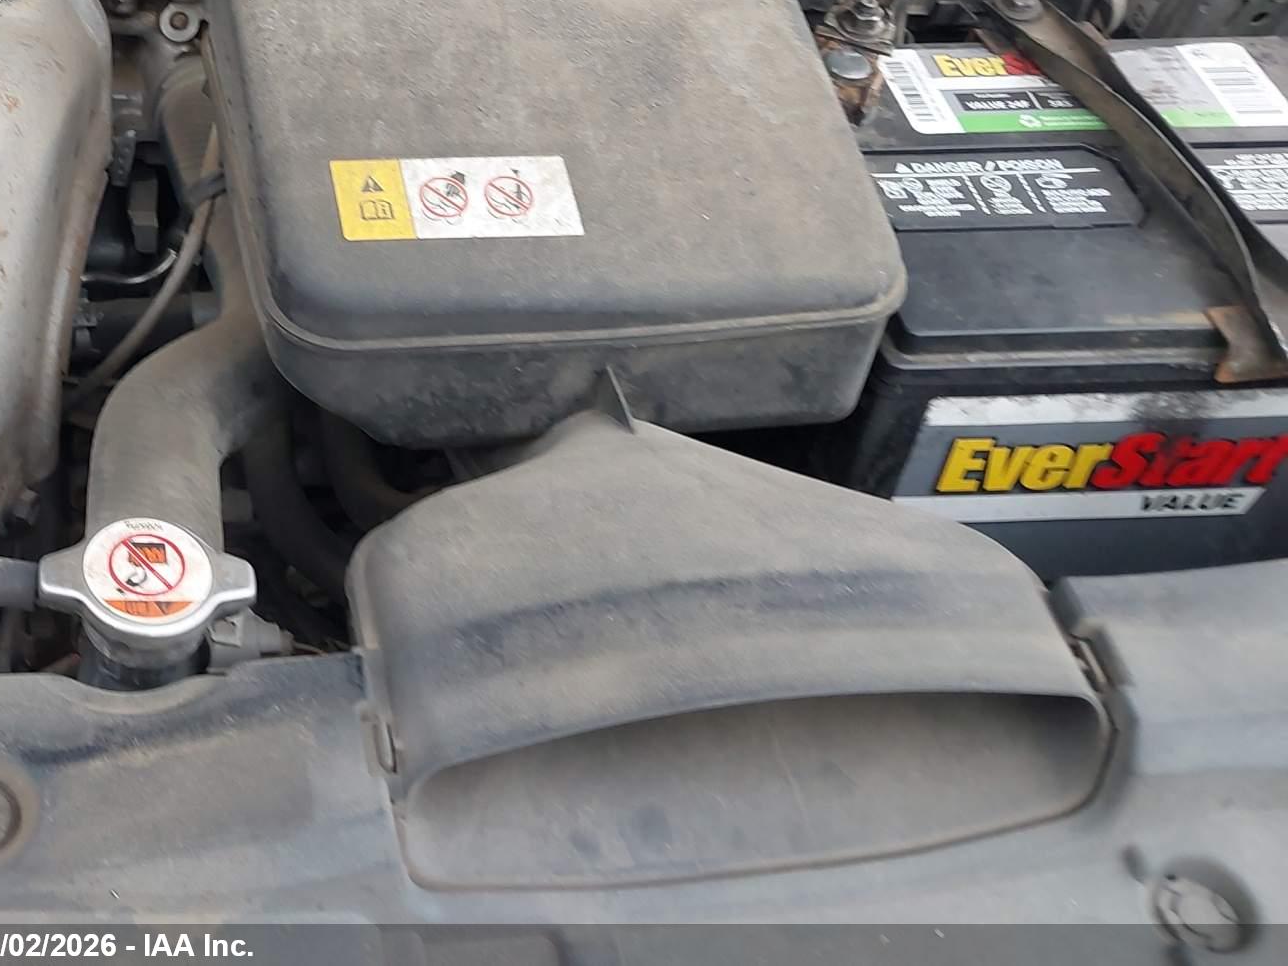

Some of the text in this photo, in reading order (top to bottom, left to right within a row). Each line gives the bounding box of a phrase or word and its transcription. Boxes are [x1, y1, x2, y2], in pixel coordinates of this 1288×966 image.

[931, 52, 1044, 77] EverS
[910, 161, 984, 173] DANGER
[996, 158, 1065, 171] POISON
[936, 431, 1288, 492] EverStart
[1140, 493, 1245, 512] VALUE
